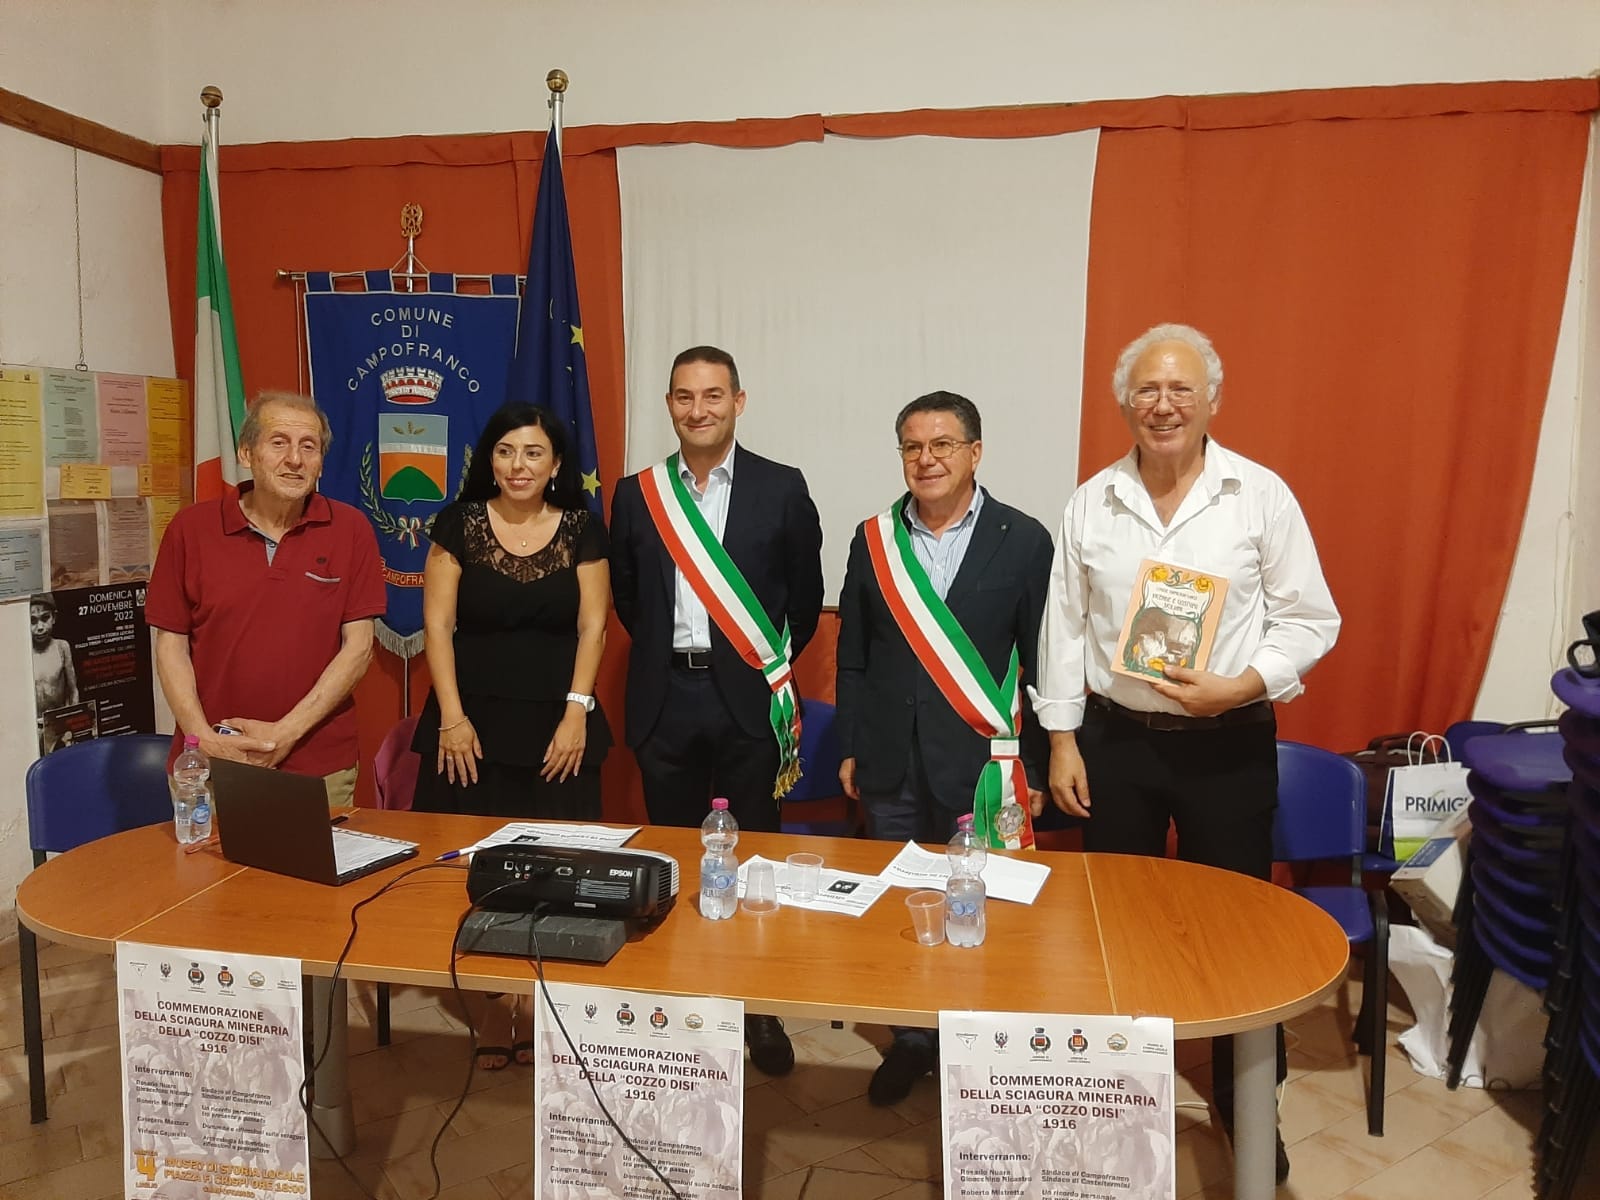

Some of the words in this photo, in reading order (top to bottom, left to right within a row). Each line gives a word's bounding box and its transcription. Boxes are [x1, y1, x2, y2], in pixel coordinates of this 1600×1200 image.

[371, 307, 454, 328] COMUNE
[401, 325, 419, 338] DI
[347, 342, 481, 393] CAMPOFRANCO
[89, 590, 133, 603] DOMENICA
[78, 606, 89, 616] 27
[90, 600, 134, 614] NOVEMBRE
[114, 611, 134, 622] 2022
[1405, 796, 1468, 812] PRIMIG
[609, 868, 633, 878] EPSON
[157, 1000, 264, 1021] COMMEMORAZIONE
[134, 1010, 167, 1022] DELLA
[169, 1014, 225, 1029] SCIAGURA
[227, 1020, 289, 1036] MINERARIA
[158, 1025, 191, 1038] DELLA
[199, 1043, 228, 1054] 1916
[579, 1043, 701, 1064] COMMEMORAZIONE
[552, 1054, 589, 1067] DELLA
[592, 1058, 655, 1073] SCIAGURA
[658, 1064, 728, 1081] MINERARIA
[578, 1070, 616, 1083] DELLA
[989, 1075, 1125, 1090] COMMEMORAZIONE
[624, 1089, 656, 1101] 1916
[960, 1089, 1001, 1100] DELLA
[1005, 1089, 1074, 1102] SCIAGURA
[1078, 1091, 1157, 1108] MINERARIA
[990, 1103, 1032, 1115] DELLA
[1042, 1118, 1077, 1130] 1916
[959, 1152, 1031, 1161] Interverranno:
[164, 1157, 204, 1171] MUSEO
[206, 1161, 218, 1173] DI
[220, 1164, 260, 1178] STORIA
[263, 1168, 305, 1182] LOCALE
[164, 1169, 202, 1182] PIAZZA
[252, 1179, 273, 1190] ORE
